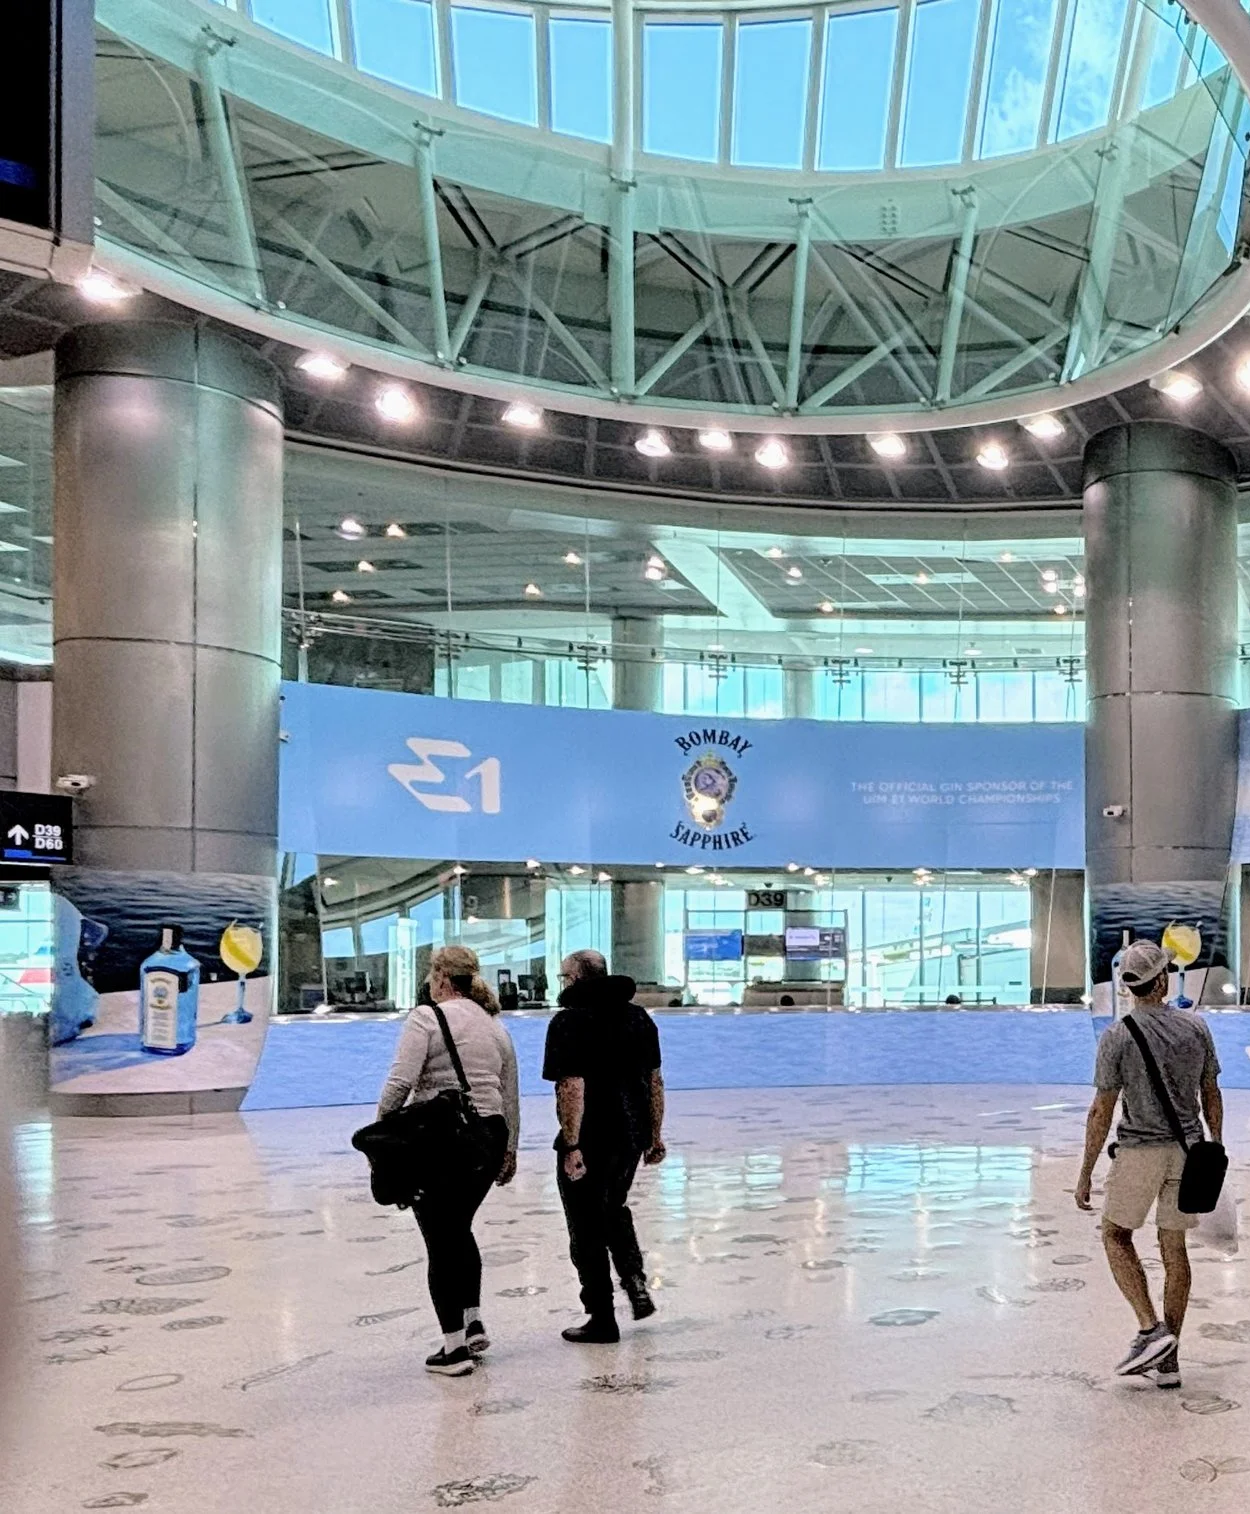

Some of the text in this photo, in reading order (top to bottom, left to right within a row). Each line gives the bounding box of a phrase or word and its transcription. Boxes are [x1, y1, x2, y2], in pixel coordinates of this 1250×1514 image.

[674, 728, 754, 759] BOMBAY
[851, 781, 876, 793] THE
[879, 781, 937, 793] OFFICIAL
[940, 781, 963, 792] GIN
[966, 781, 1027, 792] SPONSOR
[34, 823, 62, 837] D39
[669, 820, 754, 850] SAPPHIRE
[34, 837, 64, 850] D60
[748, 891, 785, 907] D39
